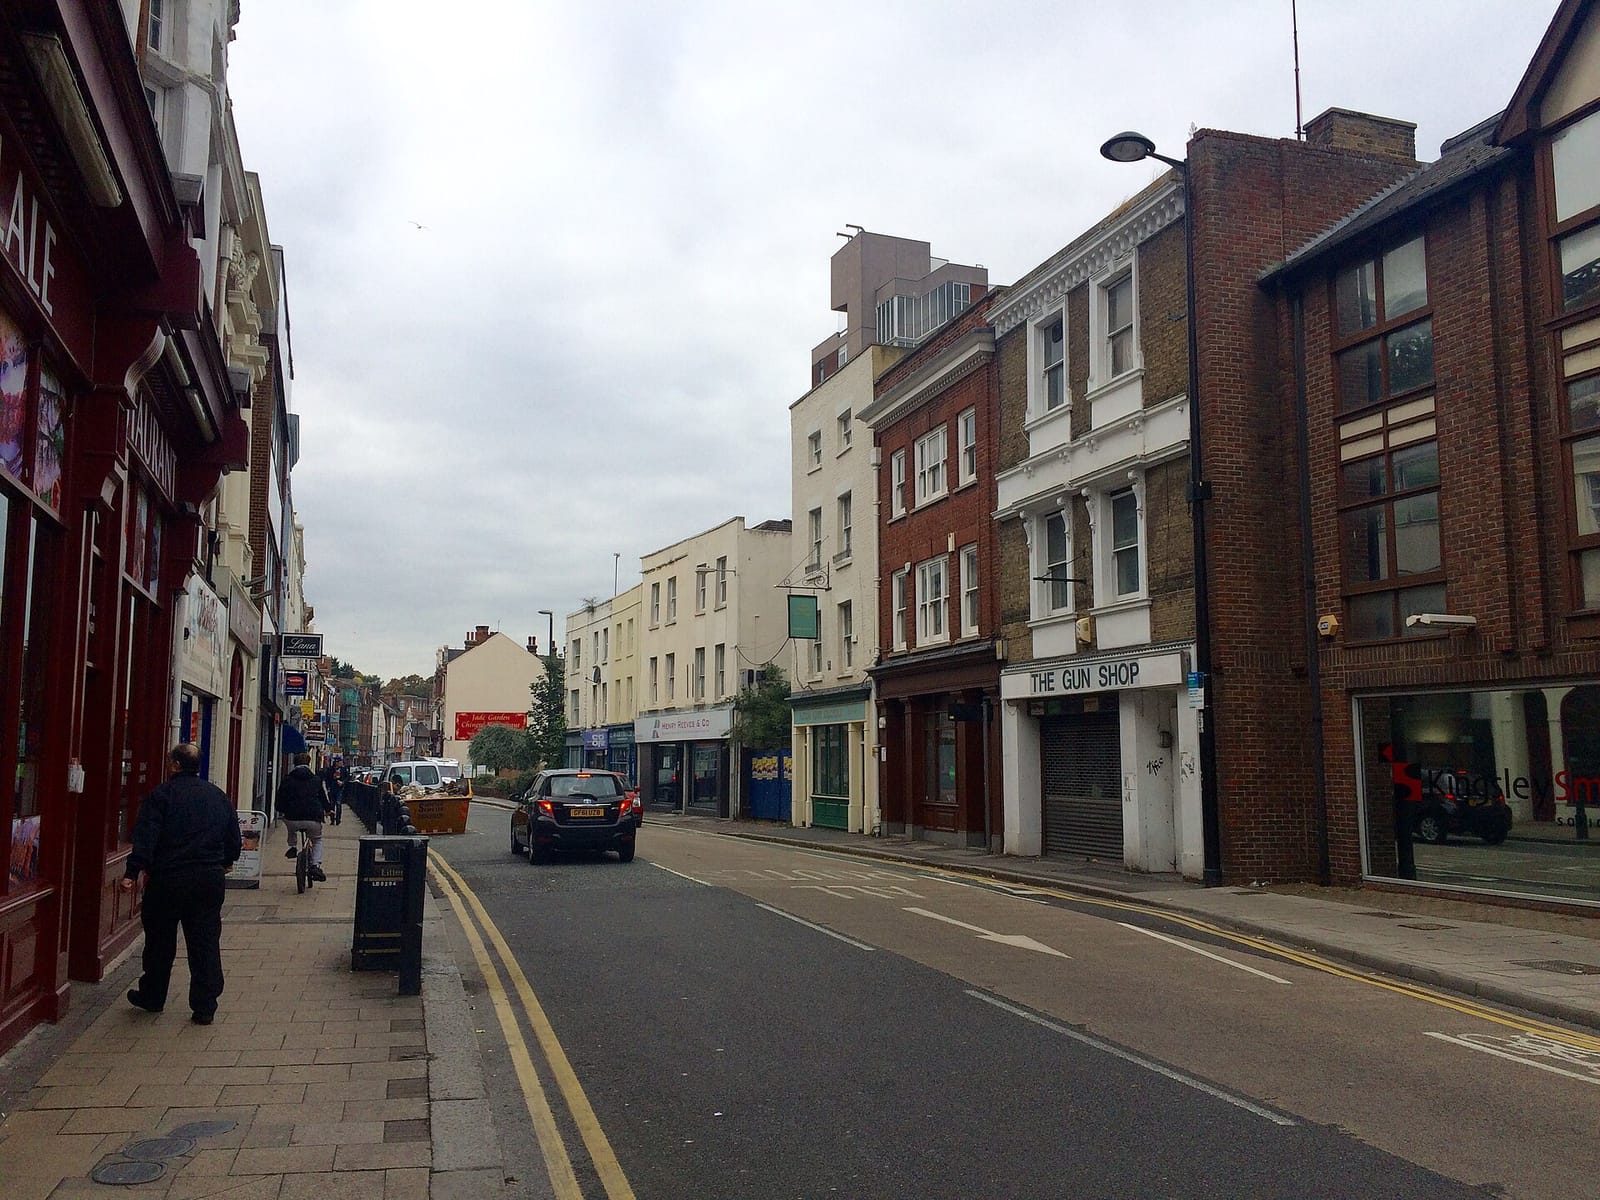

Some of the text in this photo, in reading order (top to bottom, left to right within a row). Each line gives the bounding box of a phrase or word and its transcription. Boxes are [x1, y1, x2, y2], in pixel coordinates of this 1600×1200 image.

[0, 170, 57, 318] ALE
[1031, 661, 1140, 693] THE GUN SHOP
